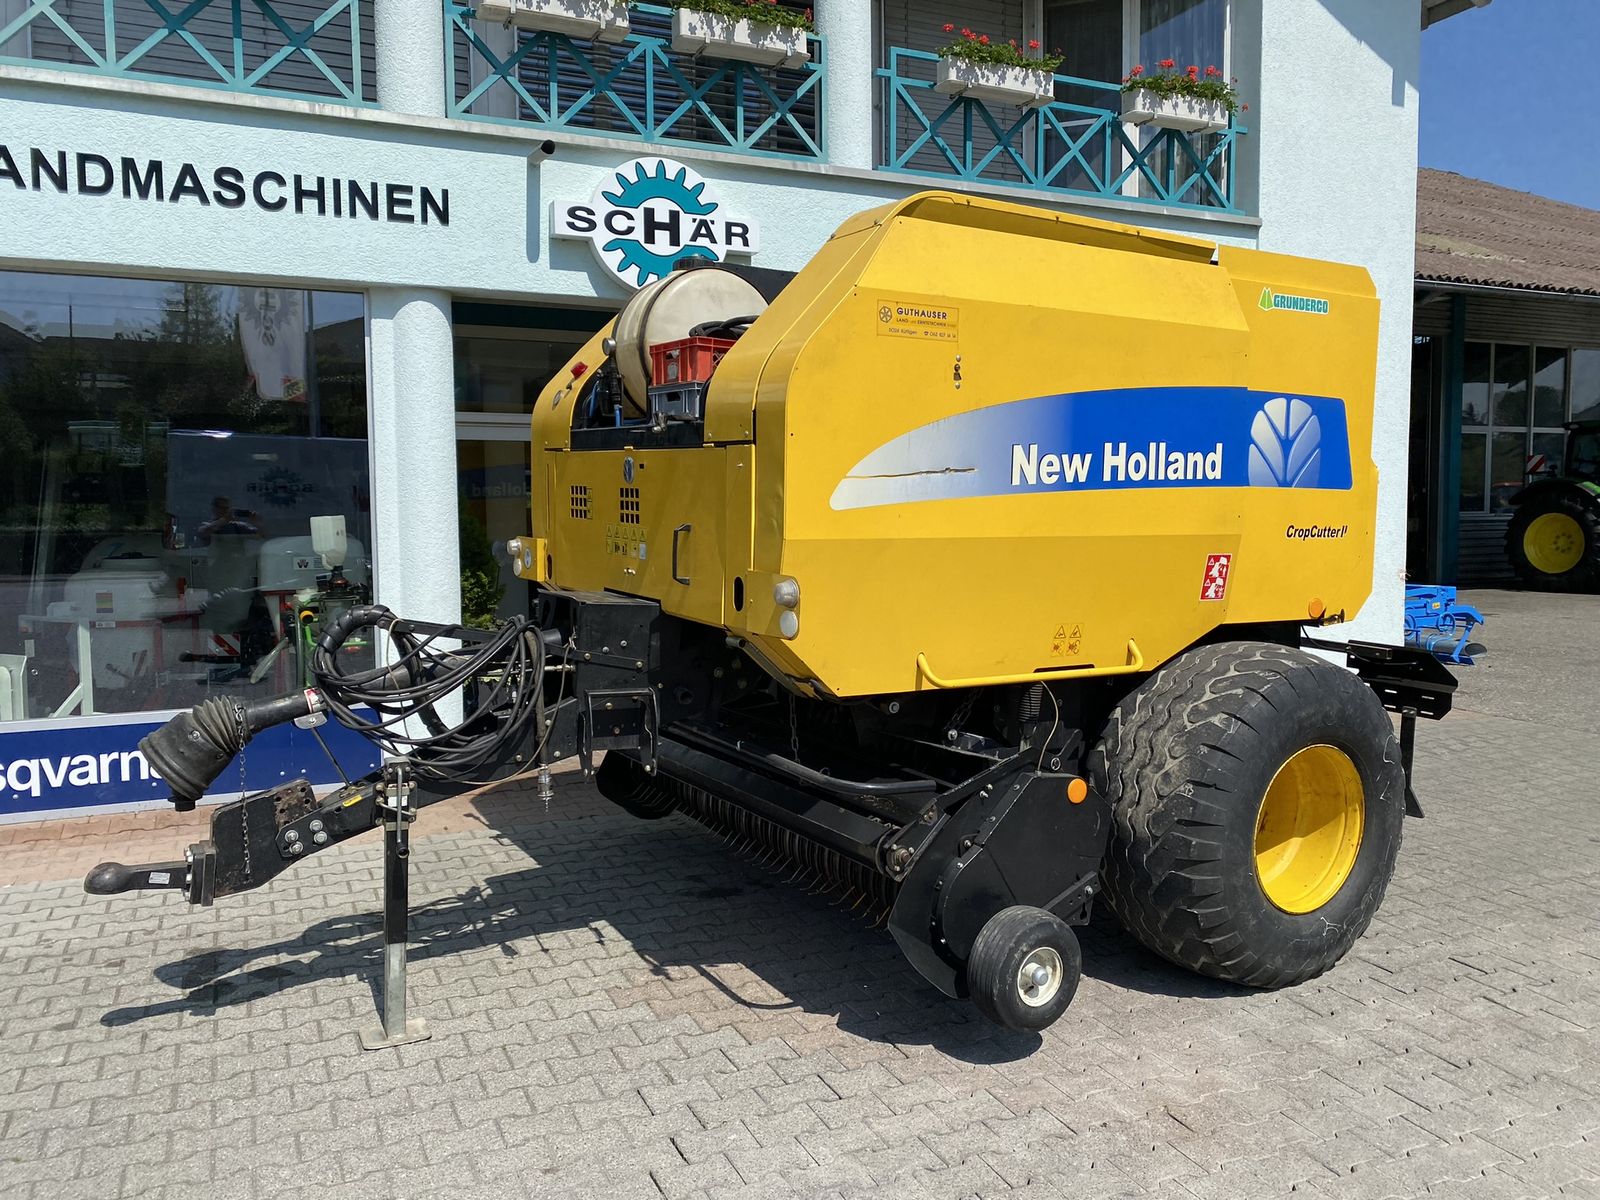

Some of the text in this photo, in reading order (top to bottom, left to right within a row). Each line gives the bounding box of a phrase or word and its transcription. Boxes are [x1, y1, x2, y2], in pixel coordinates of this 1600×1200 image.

[0, 144, 450, 227] ANDMASCHINEN
[565, 205, 750, 248] SCHÄR
[896, 307, 948, 320] GUTHAUSER
[1273, 294, 1329, 314] GRUNDERCO
[1010, 442, 1224, 486] New Holland
[0, 750, 163, 797] qvarn
